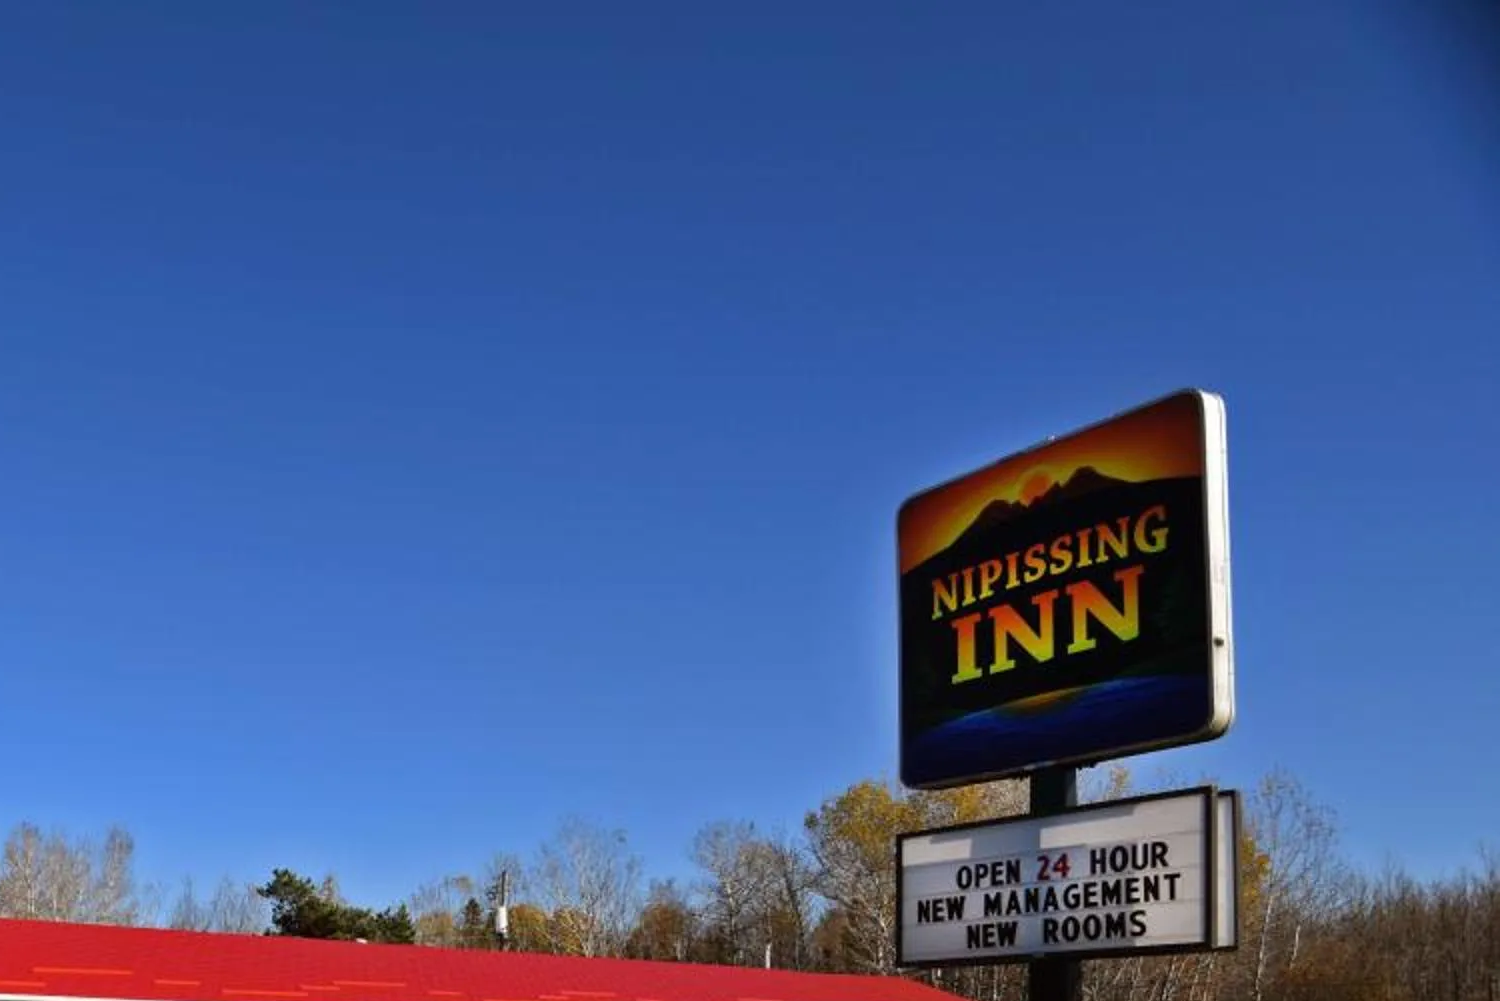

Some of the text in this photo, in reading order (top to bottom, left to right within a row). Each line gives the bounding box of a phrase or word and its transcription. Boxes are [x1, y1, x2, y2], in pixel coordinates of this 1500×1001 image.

[932, 505, 1169, 620] NIPISSING
[951, 565, 1144, 684] INN
[956, 842, 1169, 890] OPEN 24 HOUR
[917, 873, 1180, 923] NEW MANAGEMENT
[967, 910, 1147, 949] NEW ROOMS
